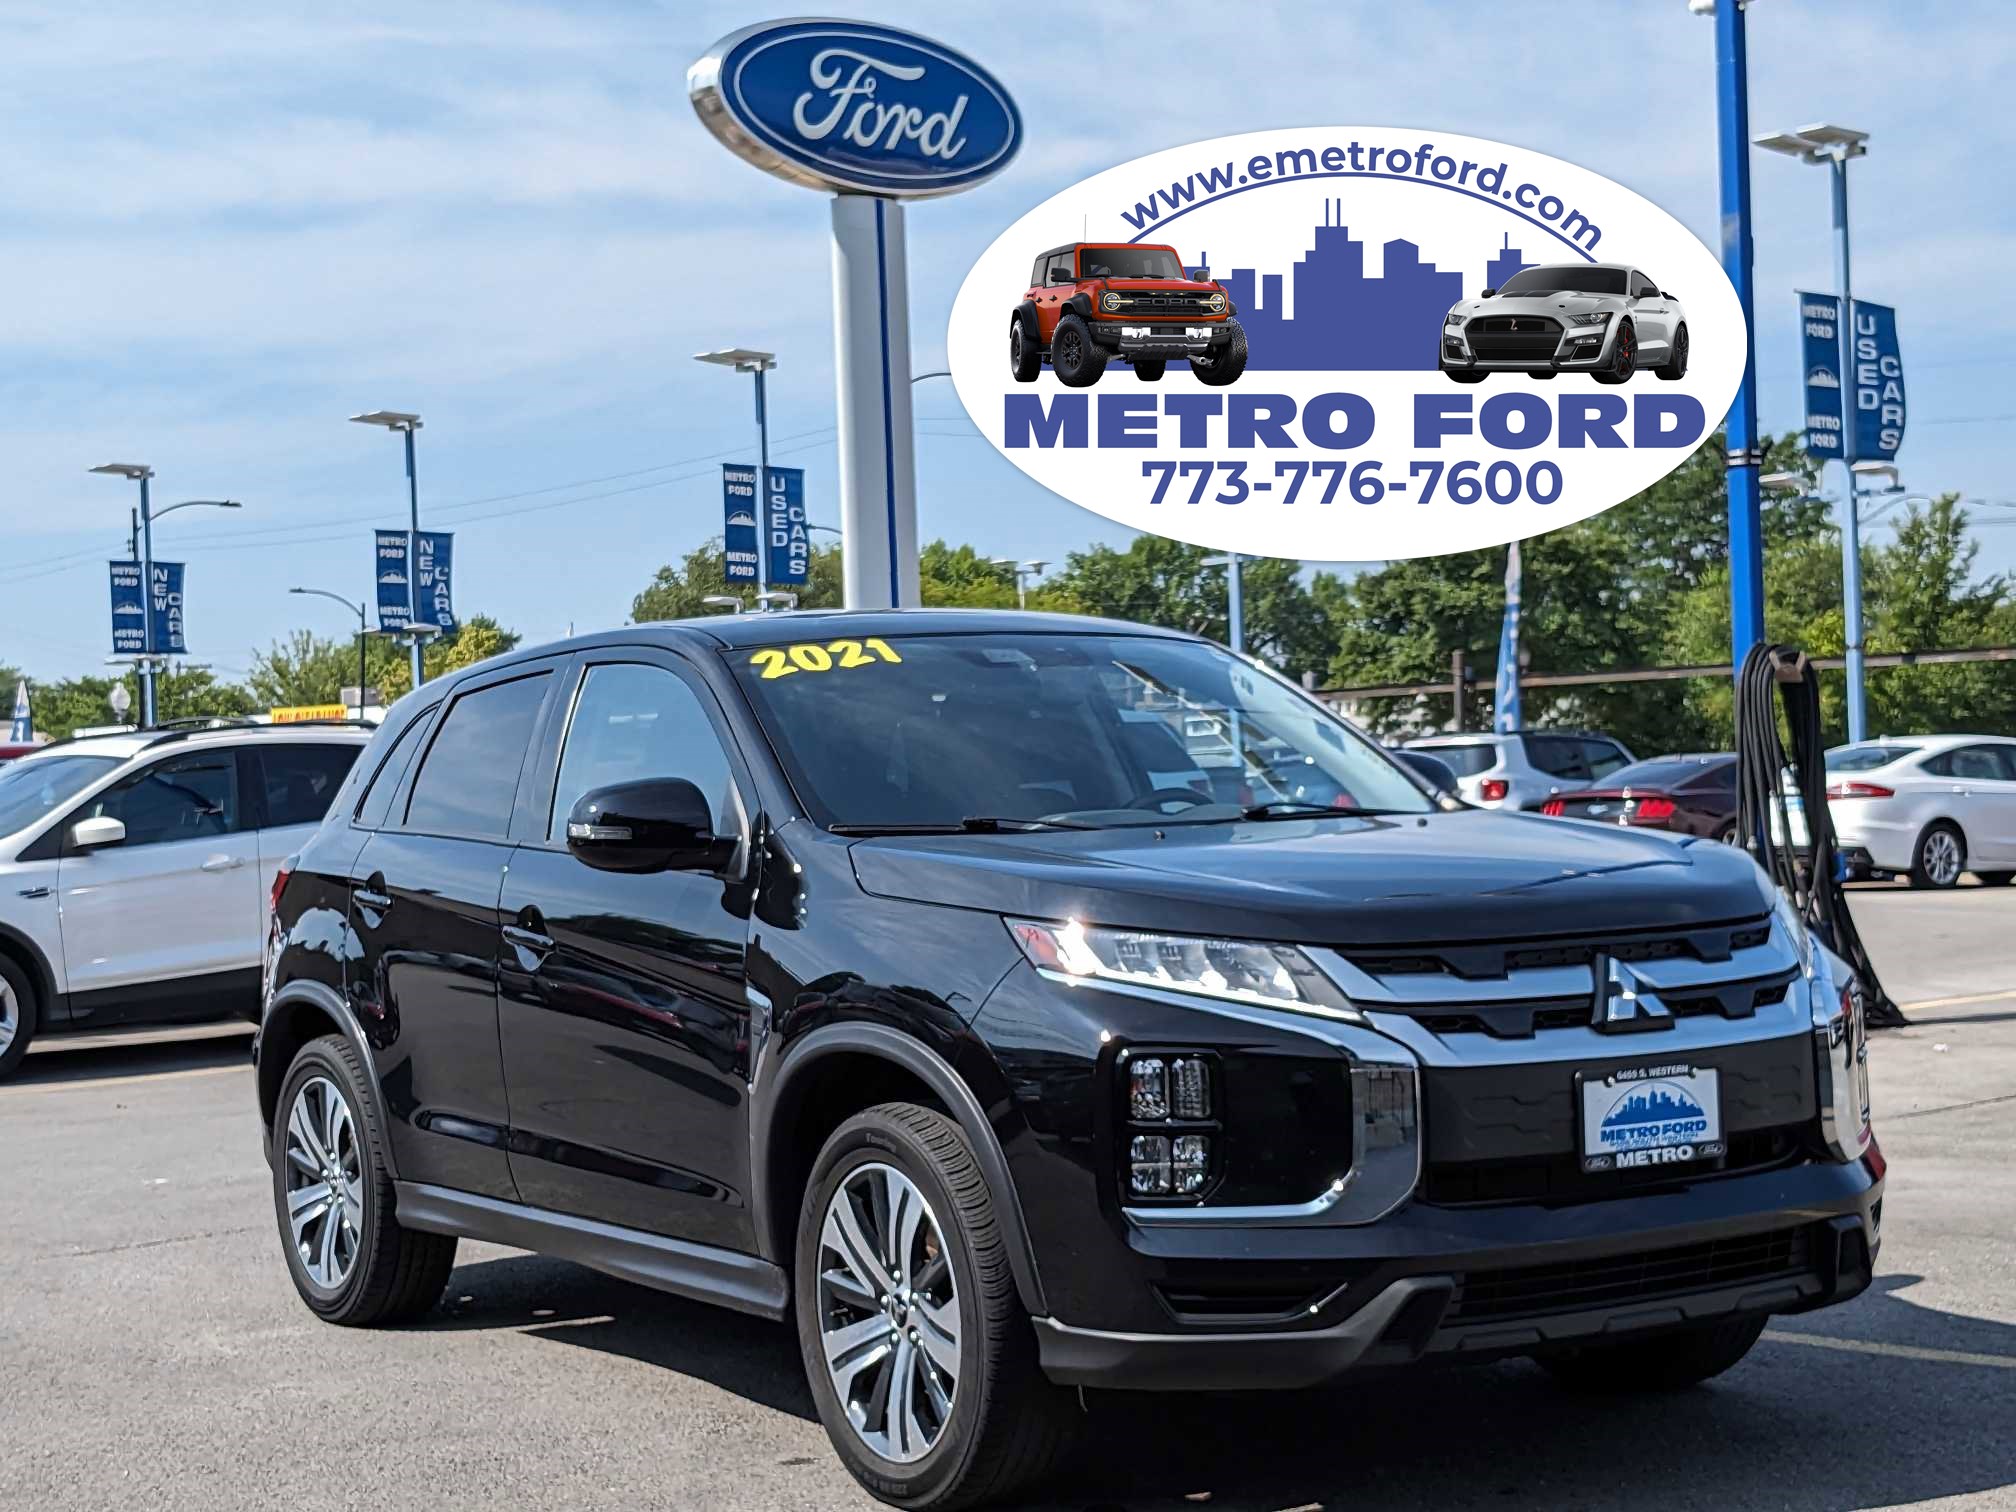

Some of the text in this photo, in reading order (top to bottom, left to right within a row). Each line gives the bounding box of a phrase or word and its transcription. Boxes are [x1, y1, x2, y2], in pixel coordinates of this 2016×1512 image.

[793, 50, 969, 159] Ford
[1803, 305, 1836, 321] METRO
[1806, 324, 1834, 339] FORD
[1857, 315, 1904, 450] USED CARS
[1807, 414, 1841, 431] METRO
[1811, 433, 1838, 449] FORD
[725, 472, 756, 484] METRO
[728, 485, 753, 497] FORD
[770, 476, 808, 575] USED CARS
[727, 551, 757, 563] METRO
[730, 565, 755, 577] FORD
[419, 539, 452, 626] NEW CARS
[154, 568, 184, 648] NEW CARS
[750, 638, 903, 679] 2021
[1600, 1125, 1660, 1143] METRO
[1662, 1119, 1707, 1135] FORD
[1616, 1145, 1694, 1169] METRO
